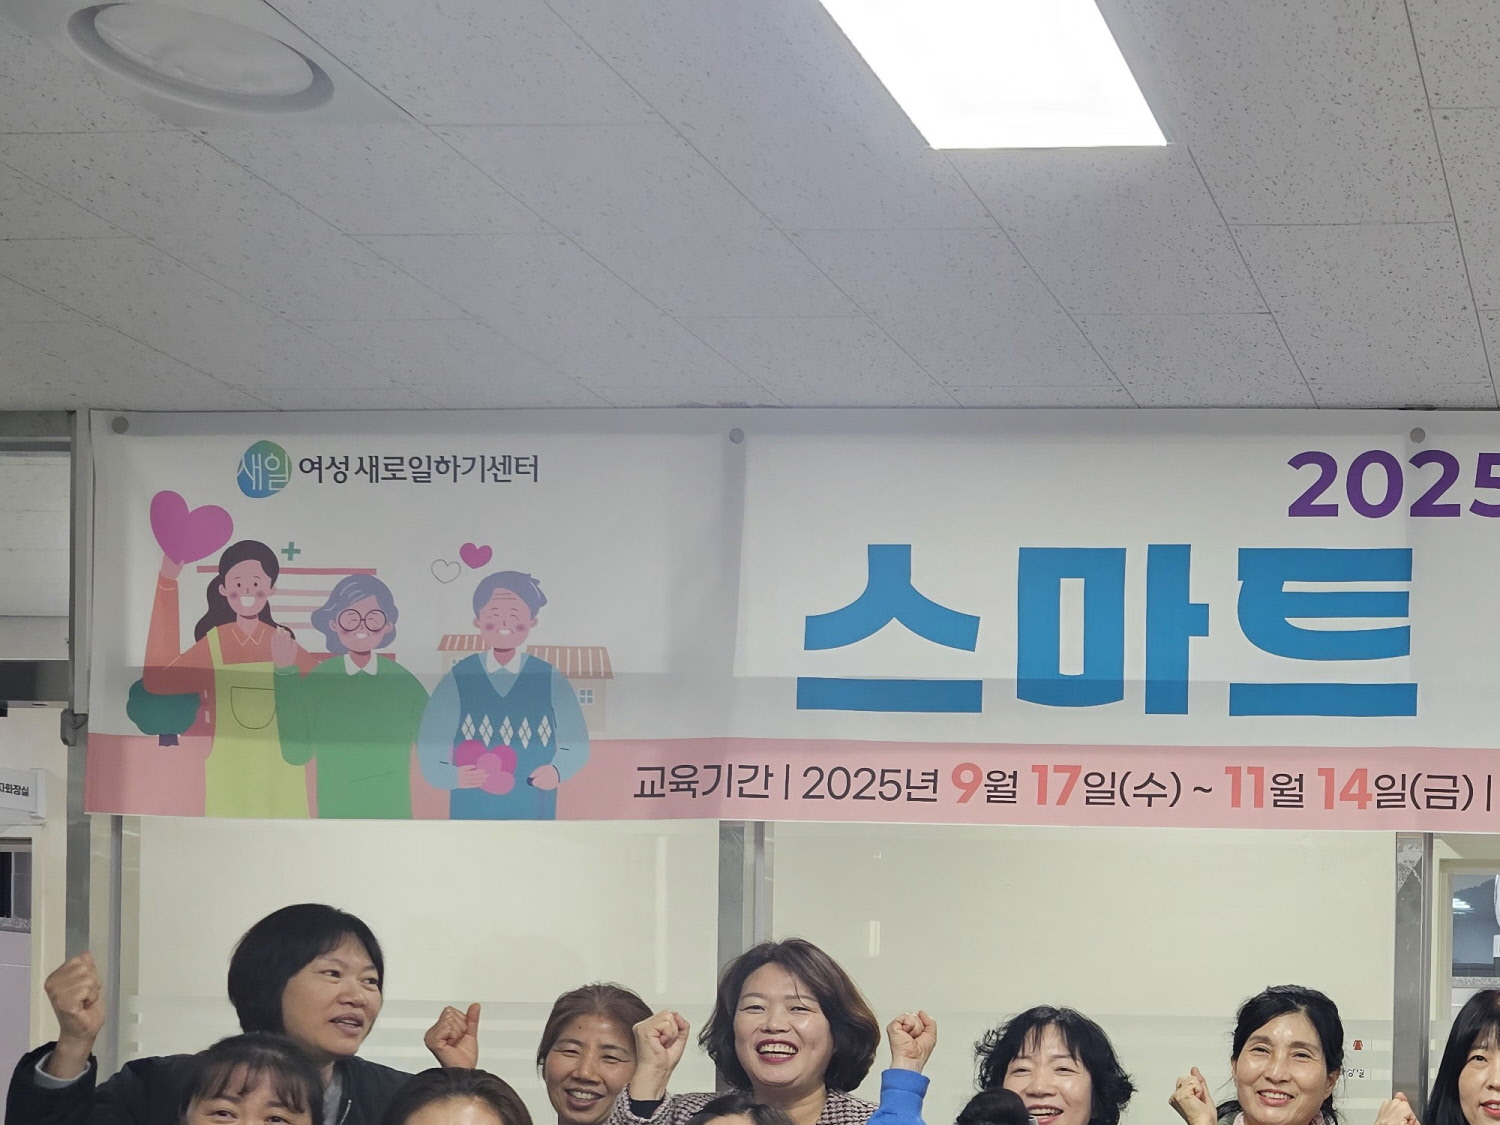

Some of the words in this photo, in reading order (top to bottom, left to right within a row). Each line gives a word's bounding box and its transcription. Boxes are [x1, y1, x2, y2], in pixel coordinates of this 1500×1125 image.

[237, 452, 290, 491] 새일
[796, 543, 1418, 717] 스마트
[633, 763, 774, 800] 교육기간
[802, 765, 939, 803] 2025년
[951, 762, 1018, 804] 9월
[1031, 764, 1182, 808] 17일(수)
[1224, 766, 1304, 809] 11월
[1317, 767, 1475, 812] 14일(금)
